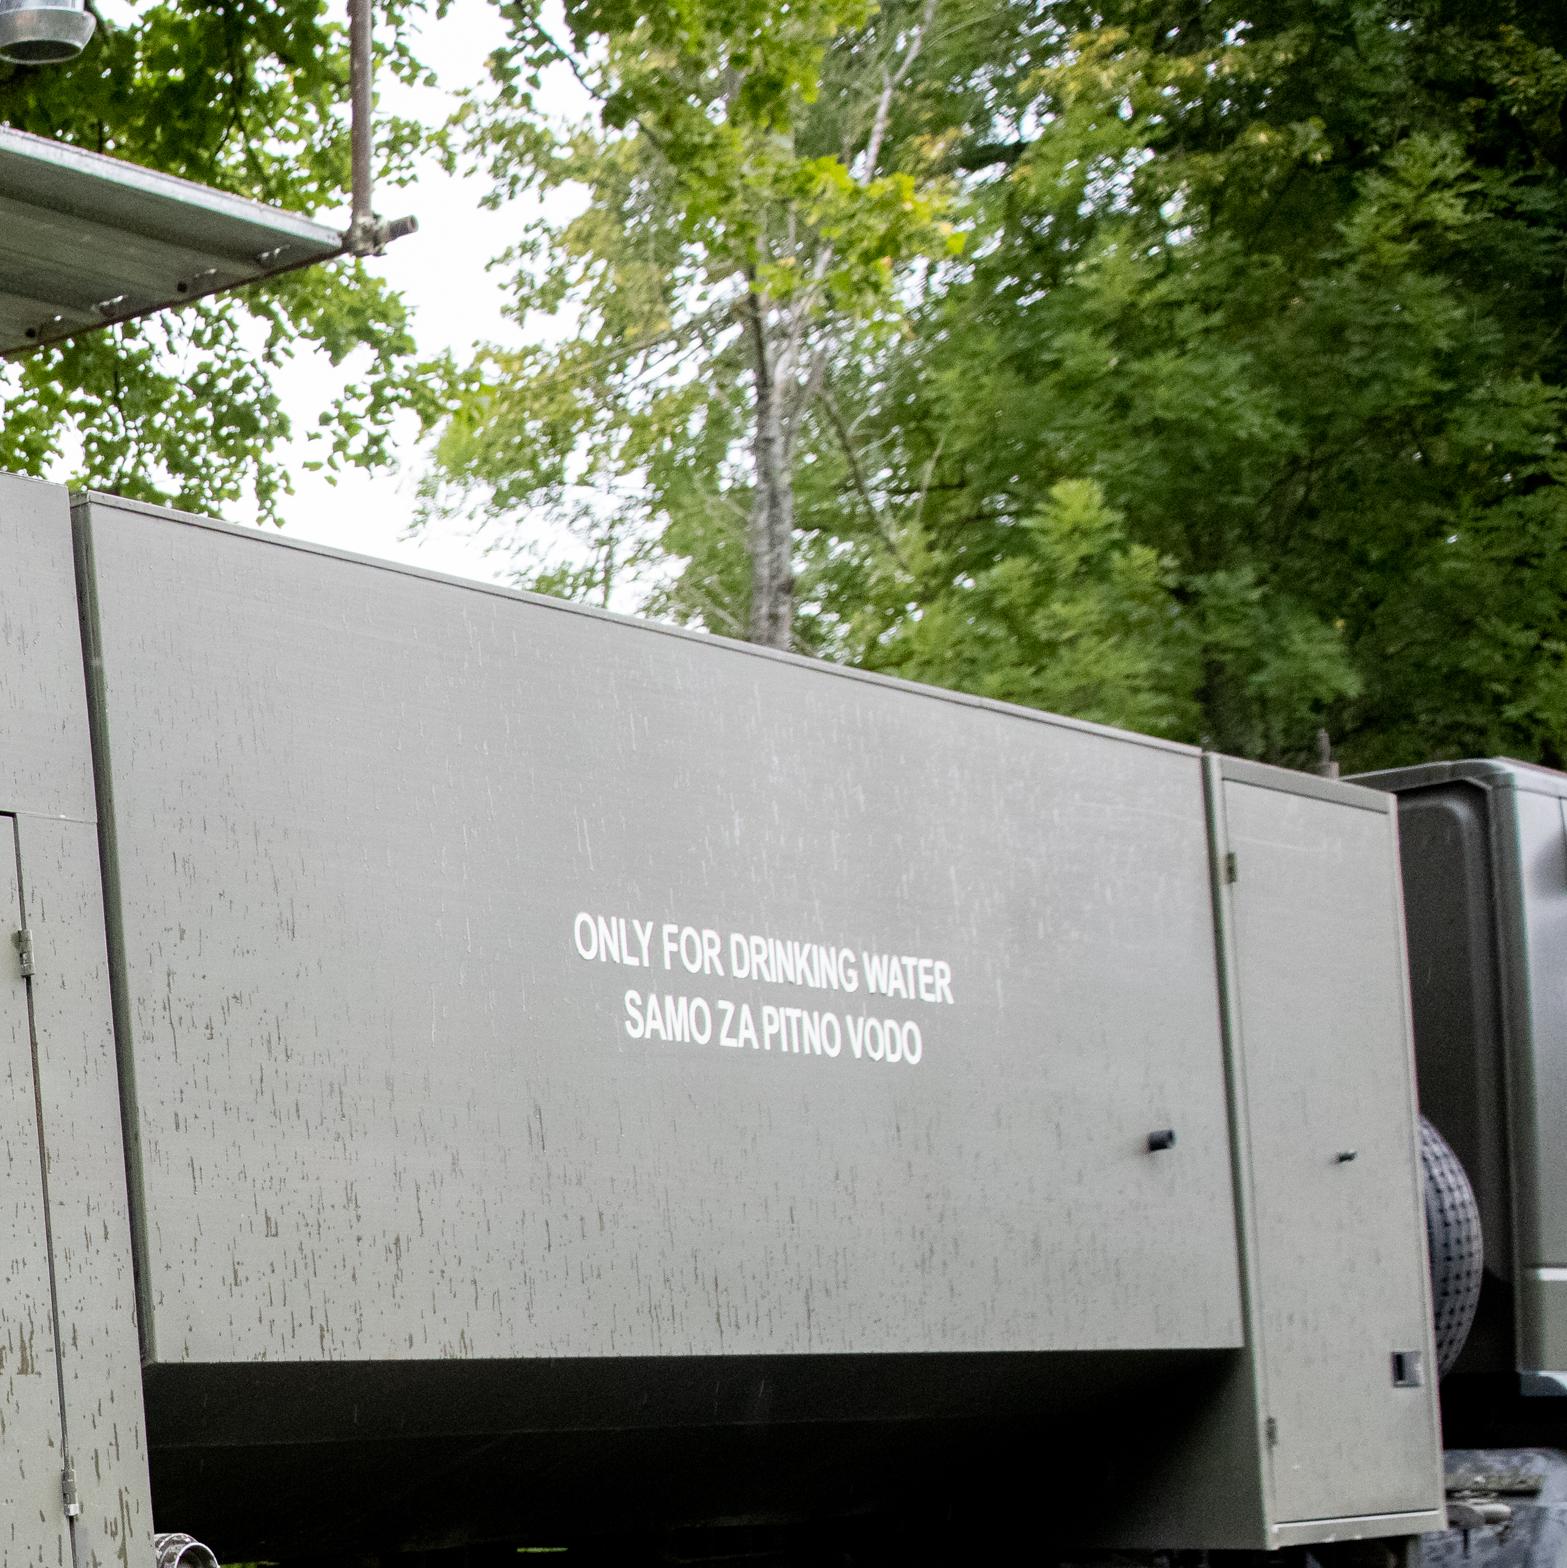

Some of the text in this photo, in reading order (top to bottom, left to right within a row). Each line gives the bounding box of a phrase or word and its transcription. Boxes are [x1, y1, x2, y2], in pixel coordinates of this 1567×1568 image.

[574, 912, 954, 1005] ONLY FOR DRINKING WATER
[624, 989, 922, 1065] SAMO ZA PITNO VODO
